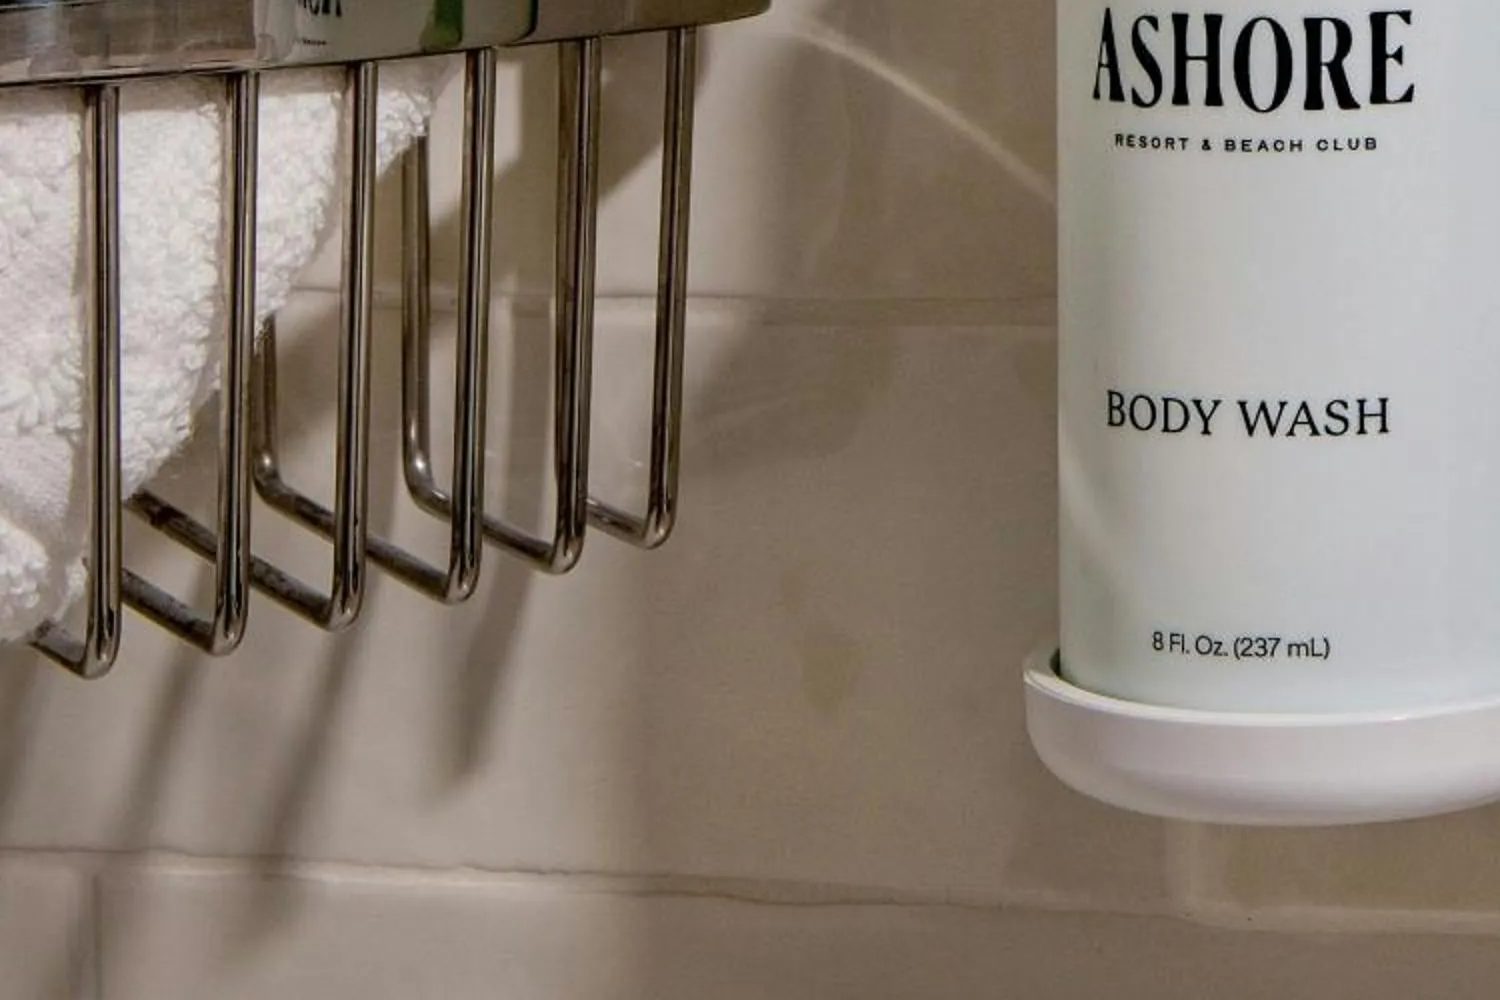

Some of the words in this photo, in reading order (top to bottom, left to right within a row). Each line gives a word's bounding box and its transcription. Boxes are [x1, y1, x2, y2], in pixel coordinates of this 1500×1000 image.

[1093, 7, 1416, 114] ASHORE
[1114, 133, 1190, 152] RESORT
[1201, 138, 1213, 152] &
[1224, 138, 1304, 153] BEACH
[1316, 136, 1378, 152] CLUB
[1106, 389, 1223, 437] BODY
[1237, 397, 1390, 438] WASH
[1152, 630, 1165, 652] 8
[1168, 632, 1190, 655] Fl.
[1194, 634, 1229, 657] Oz.
[1232, 636, 1282, 661] (237
[1287, 636, 1331, 661] mL)
